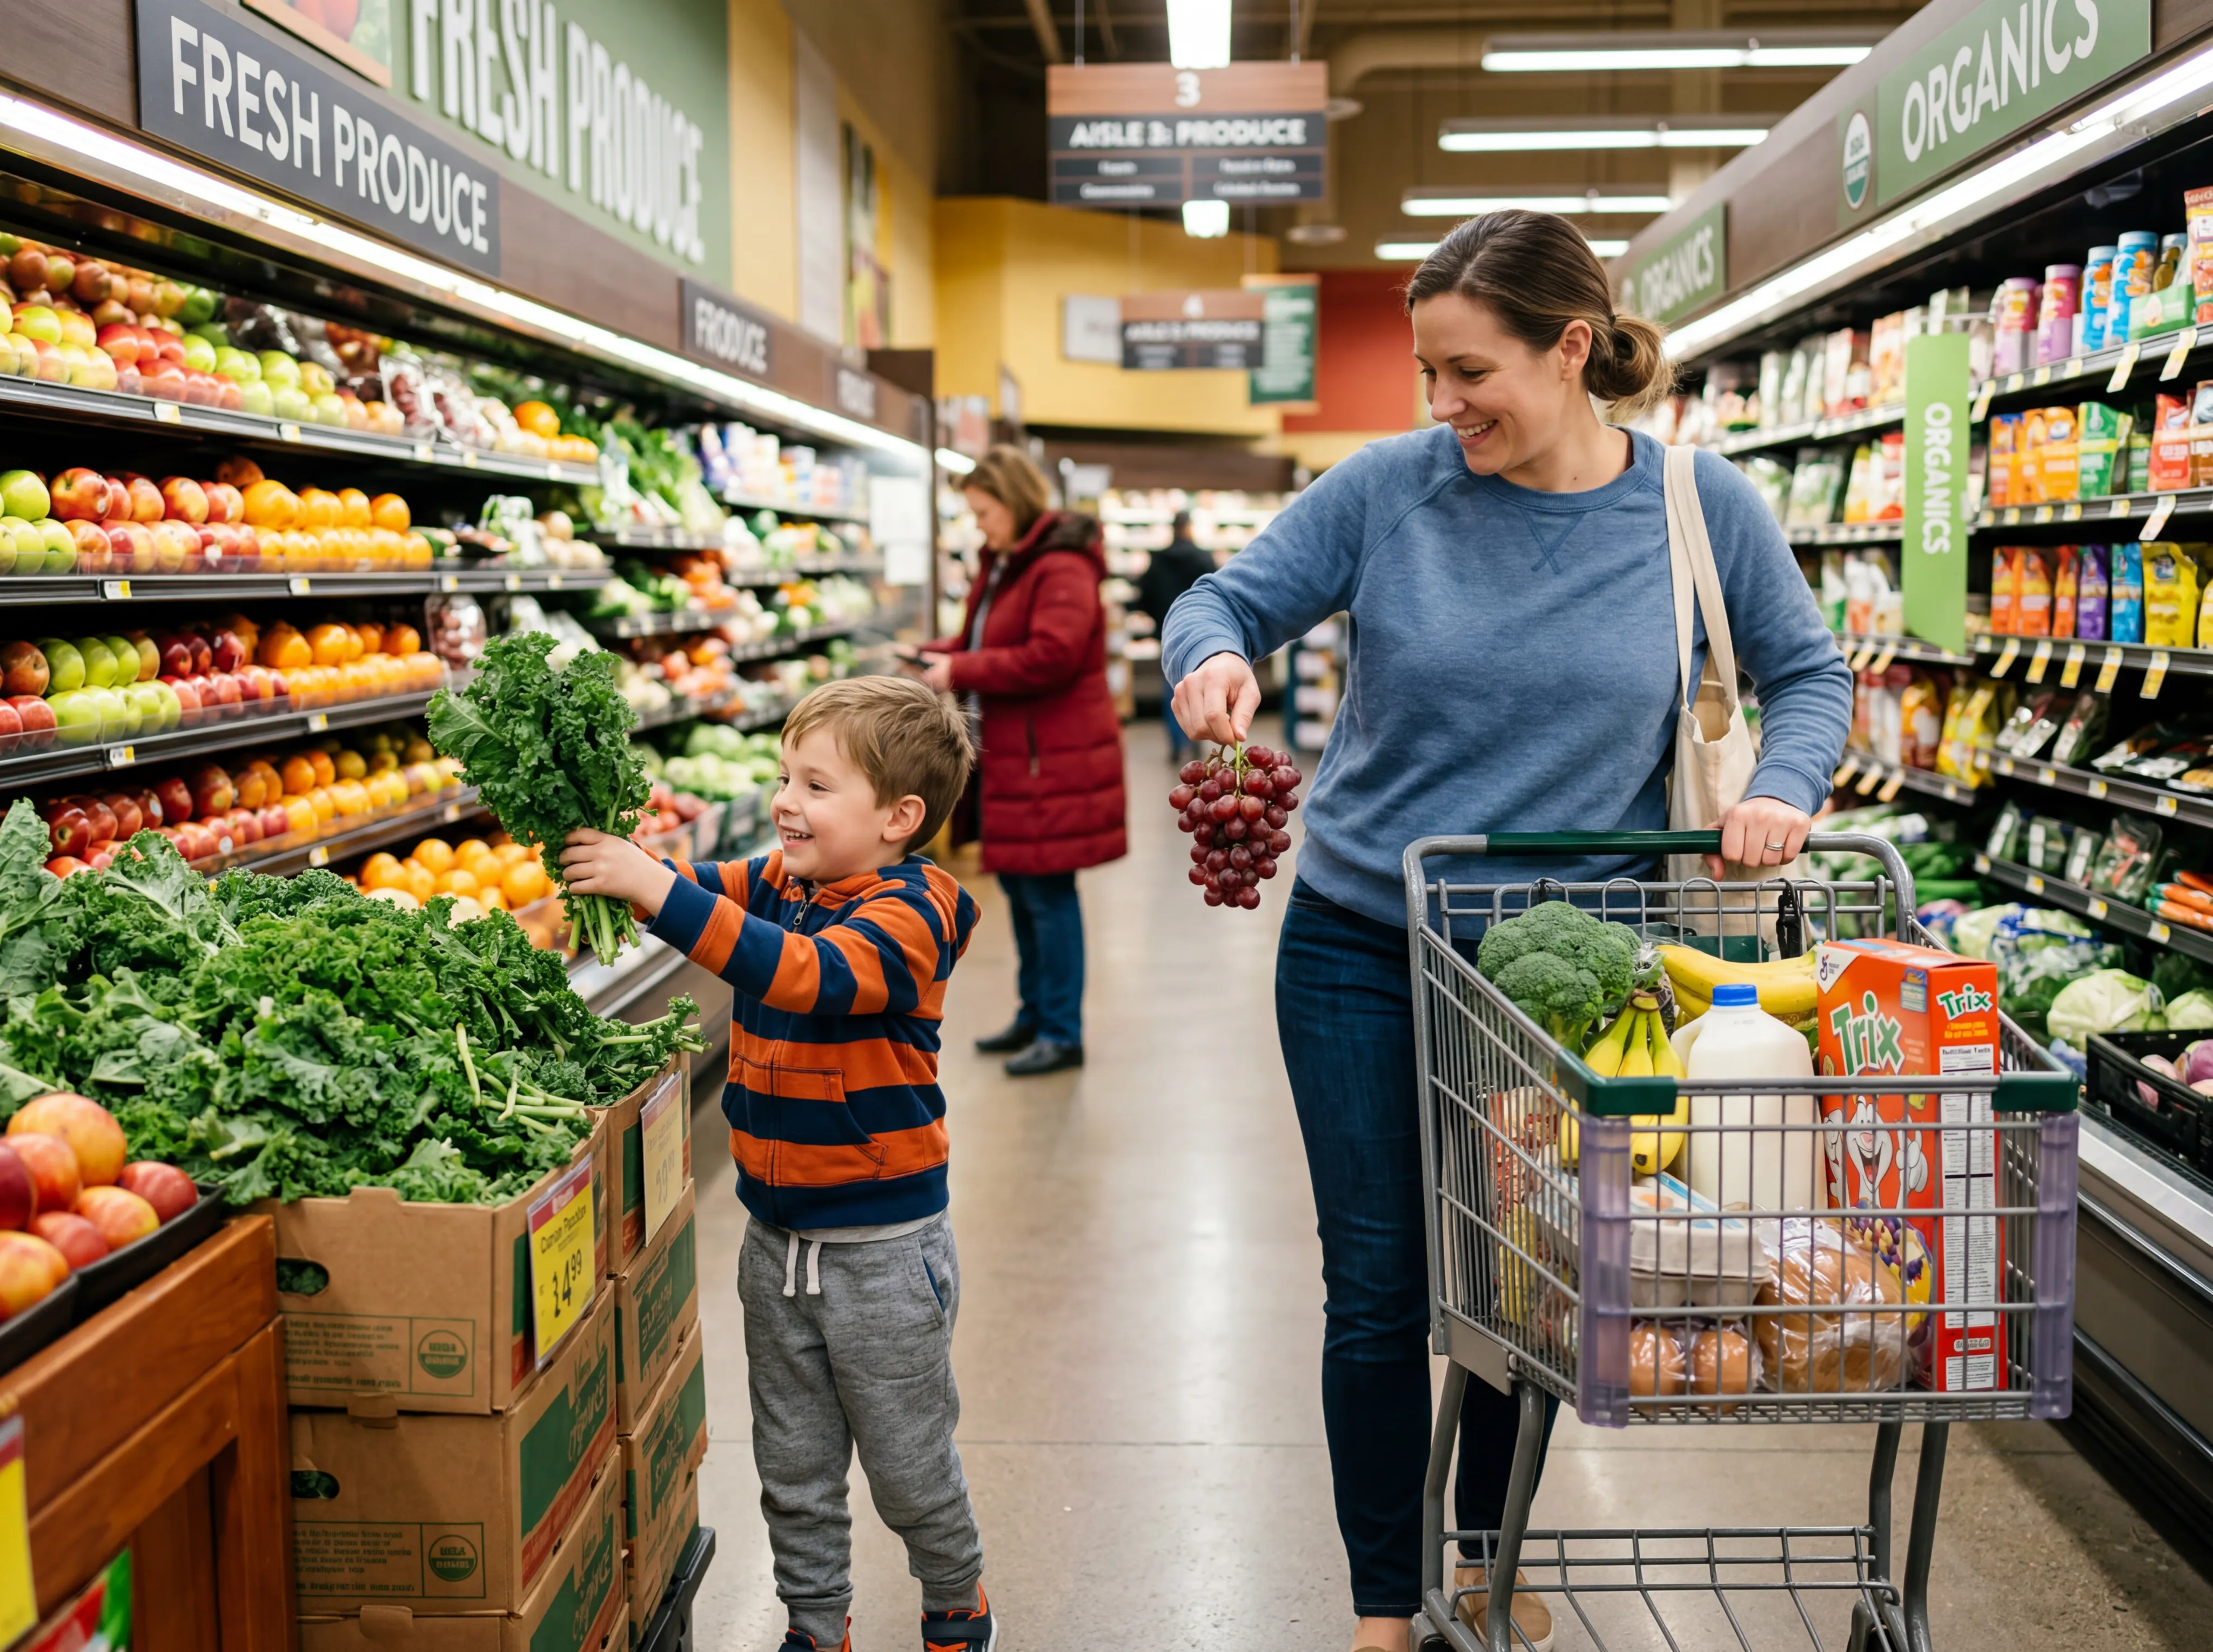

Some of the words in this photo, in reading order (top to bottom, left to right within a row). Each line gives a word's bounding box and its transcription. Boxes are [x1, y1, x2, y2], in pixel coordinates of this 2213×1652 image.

[1175, 71, 1201, 108] 3
[1902, 0, 2098, 163] ORGANICS
[171, 15, 321, 177] FRESH
[333, 104, 488, 254] PRODUCE
[413, 0, 559, 177] FRESH
[567, 21, 705, 264] PRODUCE
[1069, 121, 1145, 148] AISLE
[1176, 118, 1307, 146] PRODUCE
[1640, 225, 1714, 320] ORGANICS
[695, 297, 767, 375] PRODUCE
[1922, 401, 1953, 555] ORGANICS
[1829, 990, 1905, 1076] Trix
[1936, 983, 1993, 1021] Trix
